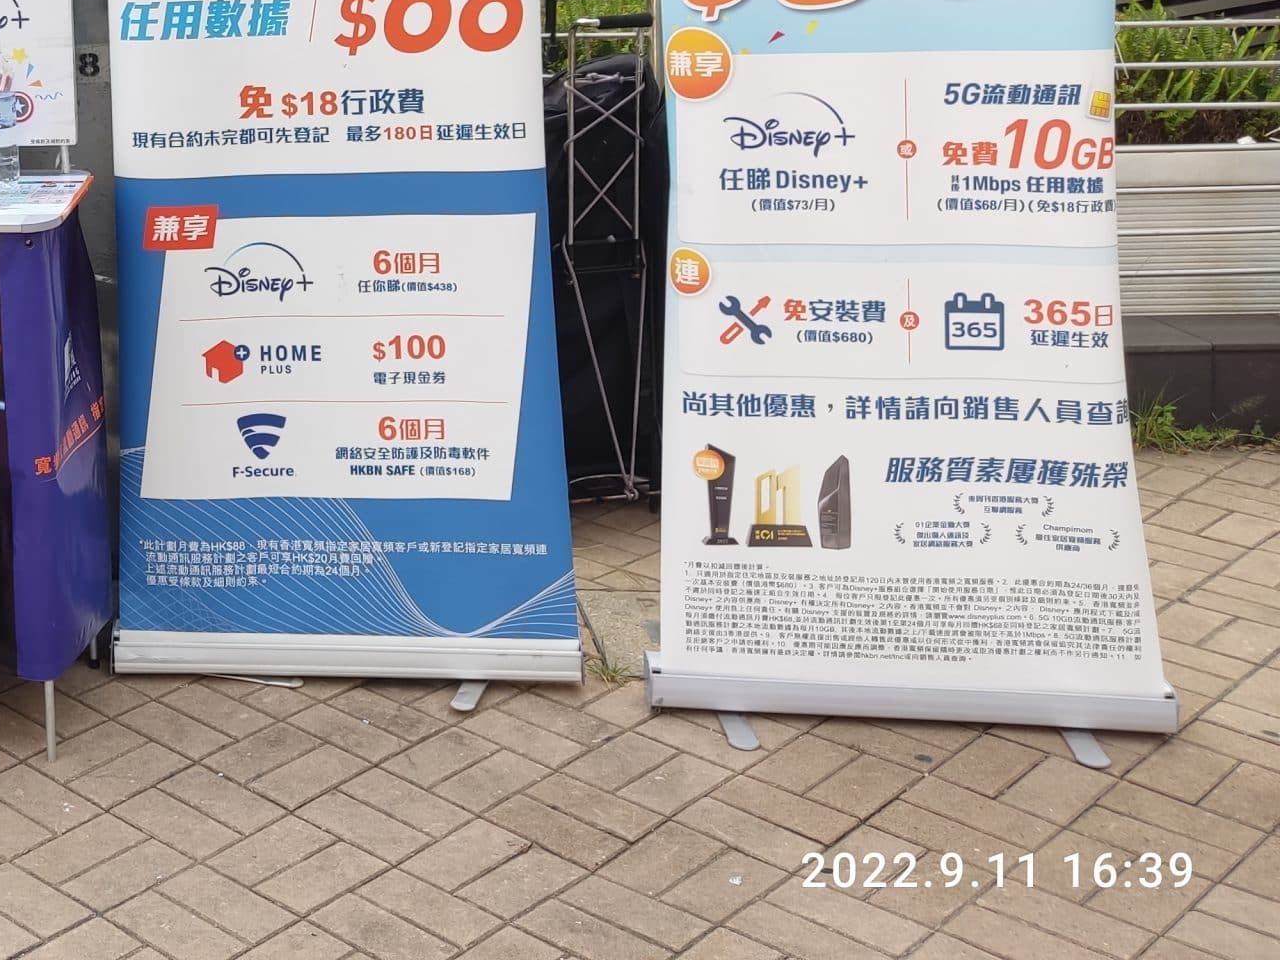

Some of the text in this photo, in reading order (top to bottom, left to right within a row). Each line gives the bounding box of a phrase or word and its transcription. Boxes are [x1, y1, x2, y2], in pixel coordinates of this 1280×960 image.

[669, 49, 724, 77] 兼享
[239, 85, 425, 120] 免 $18行政費
[944, 82, 1081, 107] 5G流動通訊
[132, 122, 527, 148] 現有合約未完都可先登記 最多180日延遲生效日
[942, 118, 1115, 172] 免費10GB
[964, 175, 1020, 195] 1Mbps
[1026, 175, 1105, 195] 任用數據
[751, 198, 835, 212] (價值$73/月)
[153, 215, 209, 242] 兼享
[373, 250, 441, 275] 6個月
[675, 258, 700, 284] 連
[784, 298, 886, 323] 免安裝費
[1024, 299, 1114, 327] 365日
[796, 329, 873, 345] (價值$680)
[952, 322, 998, 339] 365
[1030, 329, 1109, 348] 延遲生效
[260, 345, 322, 362] HOME
[372, 335, 446, 361] $100
[261, 365, 292, 375] PLUS
[373, 371, 446, 385] 電子現金券
[378, 416, 446, 441] 6個月
[232, 466, 295, 478] F-Secure
[350, 465, 383, 476] HKBN
[386, 464, 415, 476] SAFE
[885, 456, 1128, 489] 服務質素屢獲殊榮
